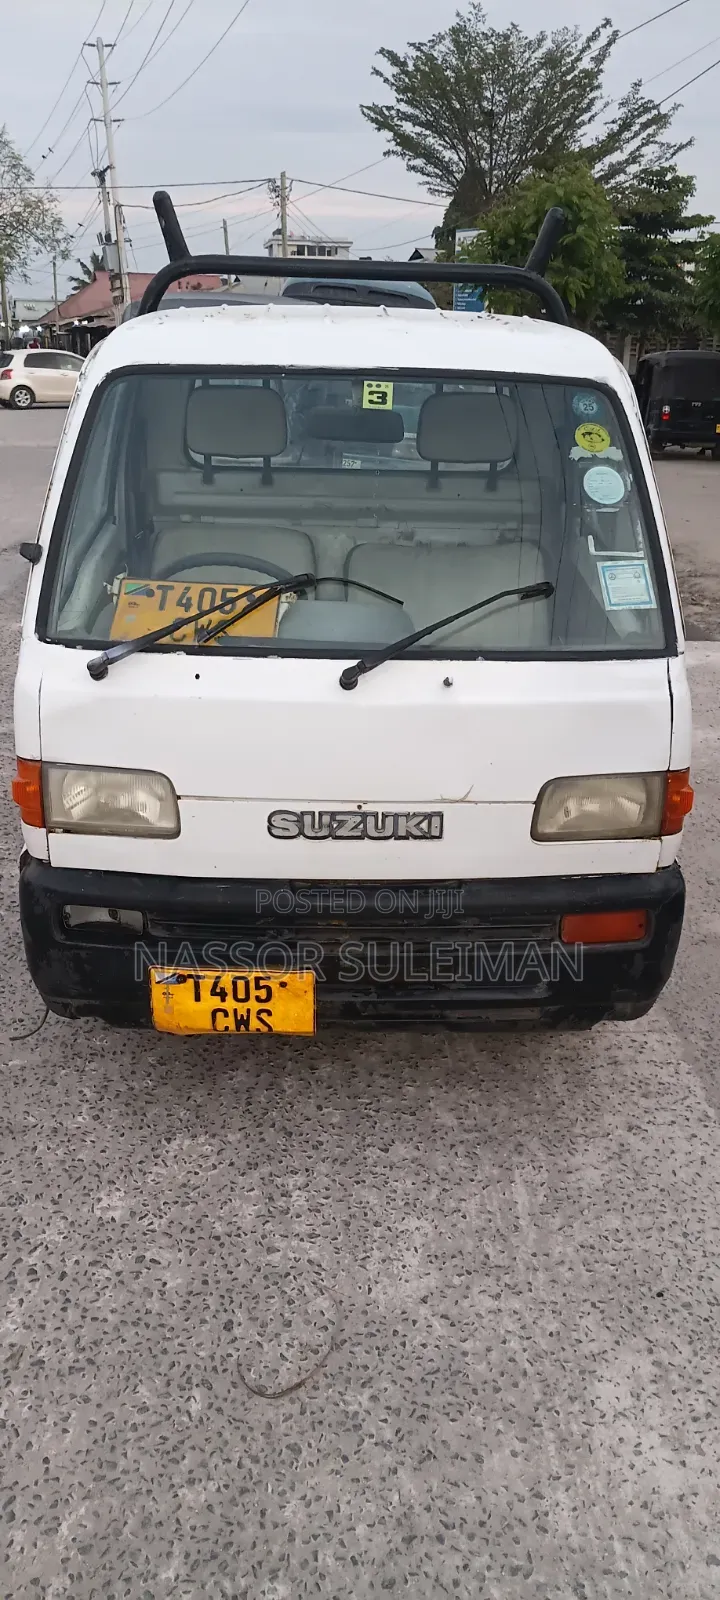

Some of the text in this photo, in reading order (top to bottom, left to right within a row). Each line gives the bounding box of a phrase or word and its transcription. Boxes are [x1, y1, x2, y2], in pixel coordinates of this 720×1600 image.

[368, 391, 388, 405] 3
[582, 403, 595, 411] 25
[155, 584, 239, 615] T405
[267, 810, 443, 840] SUZUKI
[186, 973, 273, 1003] T405
[210, 1007, 274, 1032] CWS
